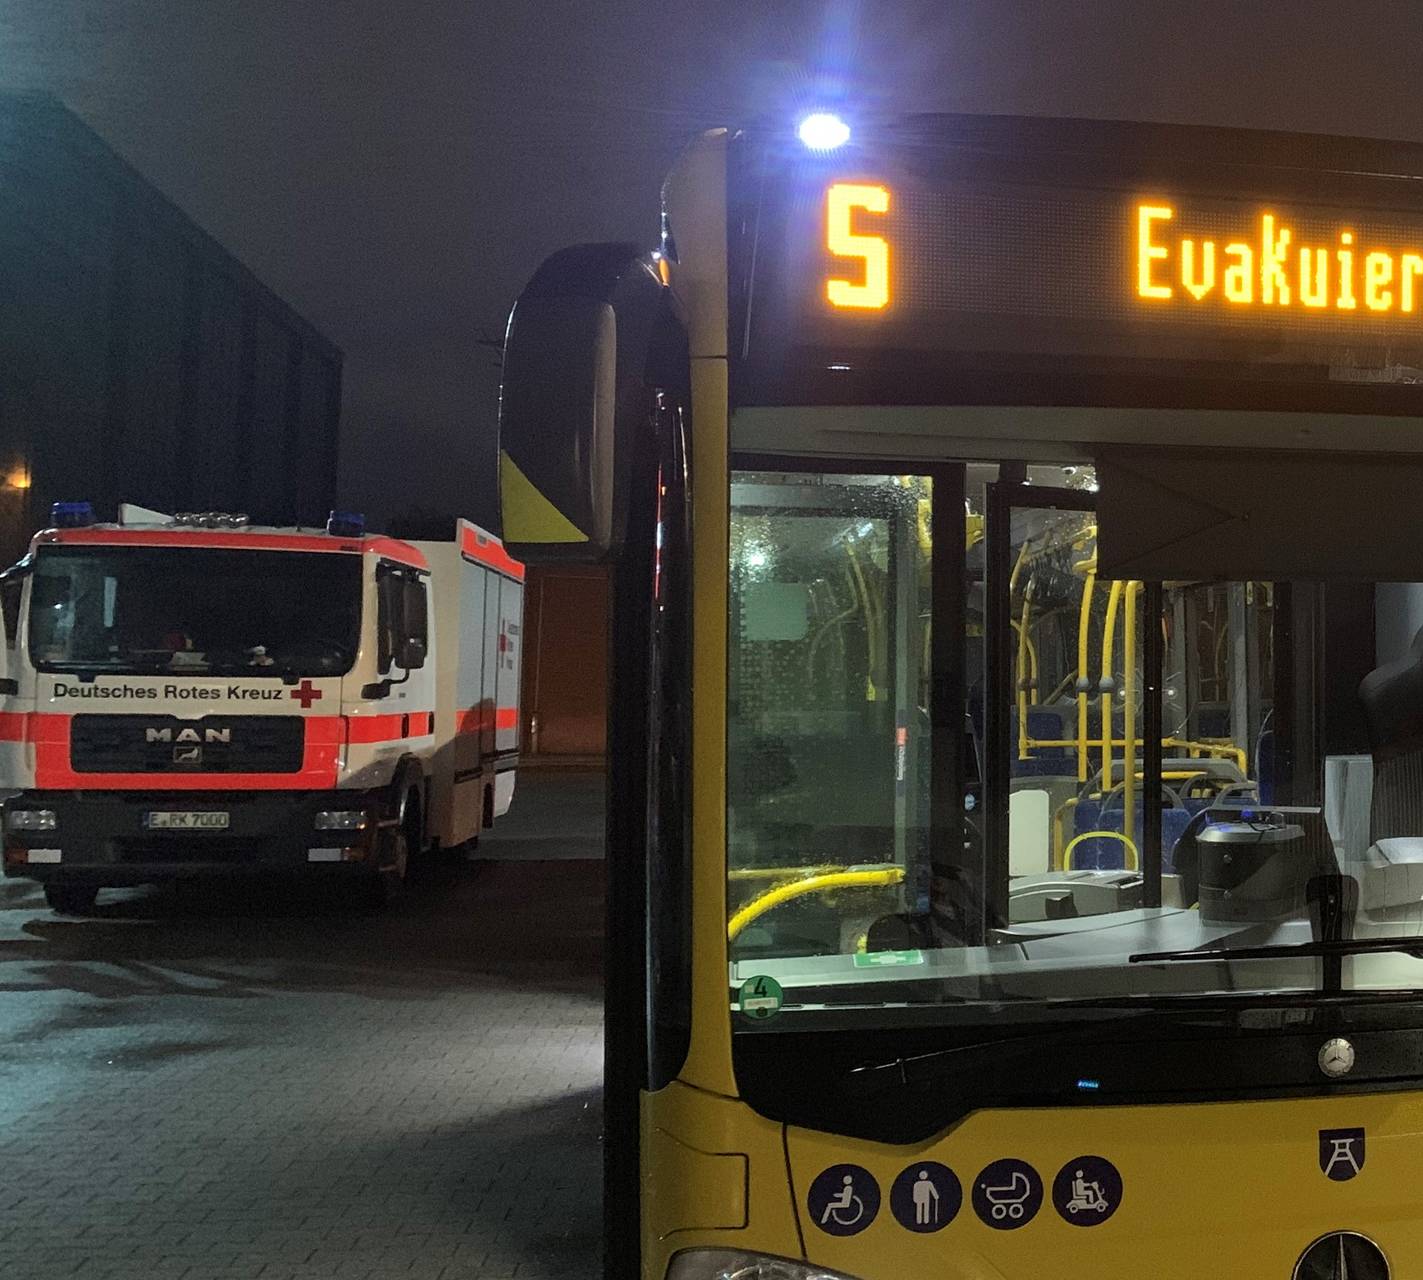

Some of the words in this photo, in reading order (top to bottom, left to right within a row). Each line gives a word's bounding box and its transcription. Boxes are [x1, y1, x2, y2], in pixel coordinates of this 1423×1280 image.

[53, 682, 157, 699] Deutsches
[164, 685, 221, 700] Rotes
[227, 685, 283, 700] Kreuz
[146, 728, 231, 742] MAN
[753, 977, 768, 998] 4
